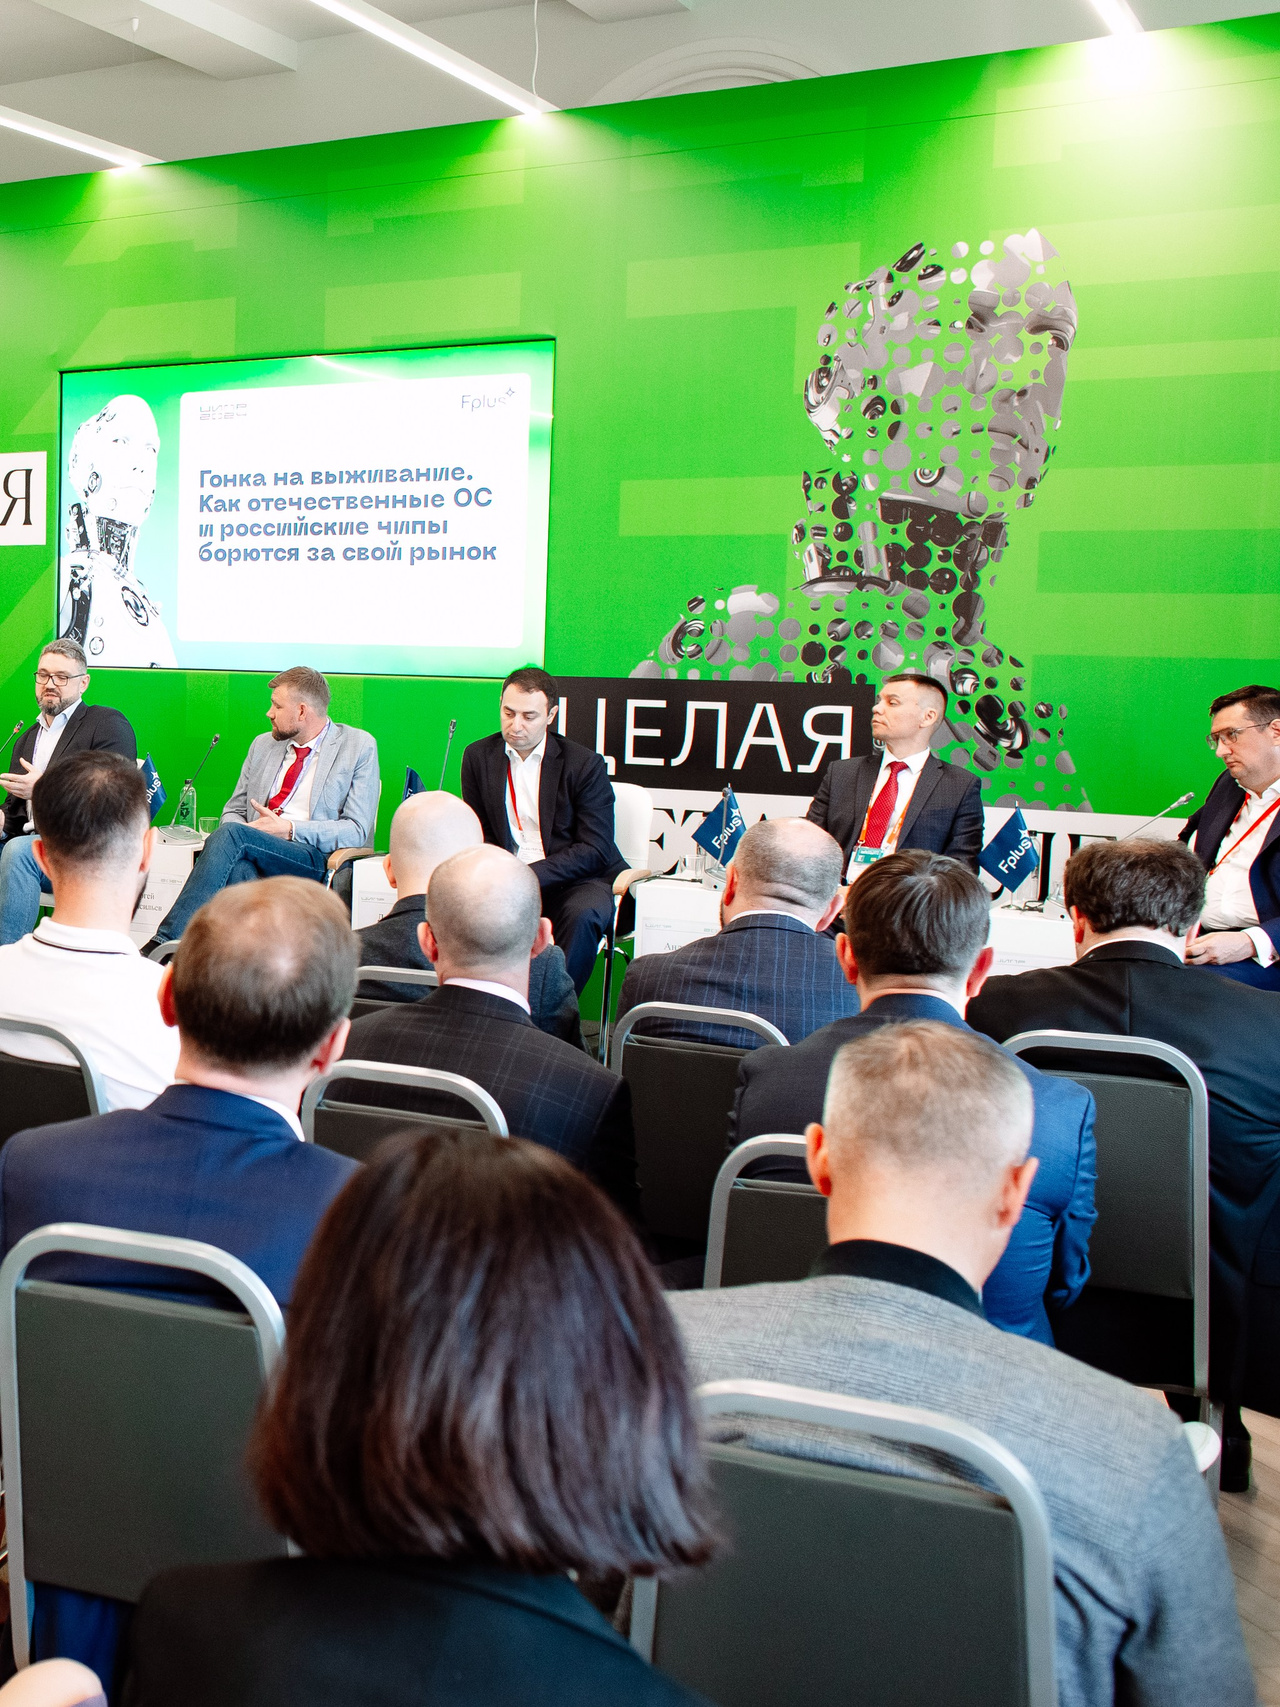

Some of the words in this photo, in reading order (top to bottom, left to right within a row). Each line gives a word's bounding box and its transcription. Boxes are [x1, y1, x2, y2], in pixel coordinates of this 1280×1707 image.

[461, 393, 507, 412] Fplus
[200, 470, 267, 488] Гонка
[273, 472, 304, 486] на
[311, 466, 473, 485] выживание.
[199, 494, 241, 513] Как
[248, 493, 445, 511] отечественные
[453, 487, 493, 507] ОС
[199, 523, 214, 537] и
[220, 516, 369, 542] российские
[378, 520, 448, 535] чипы
[198, 541, 300, 567] борются
[307, 547, 335, 562] за
[342, 540, 402, 561] свой
[410, 546, 497, 566] рынок
[146, 779, 162, 804] plus
[711, 817, 742, 849] Fplus
[998, 839, 1032, 874] Fplus
